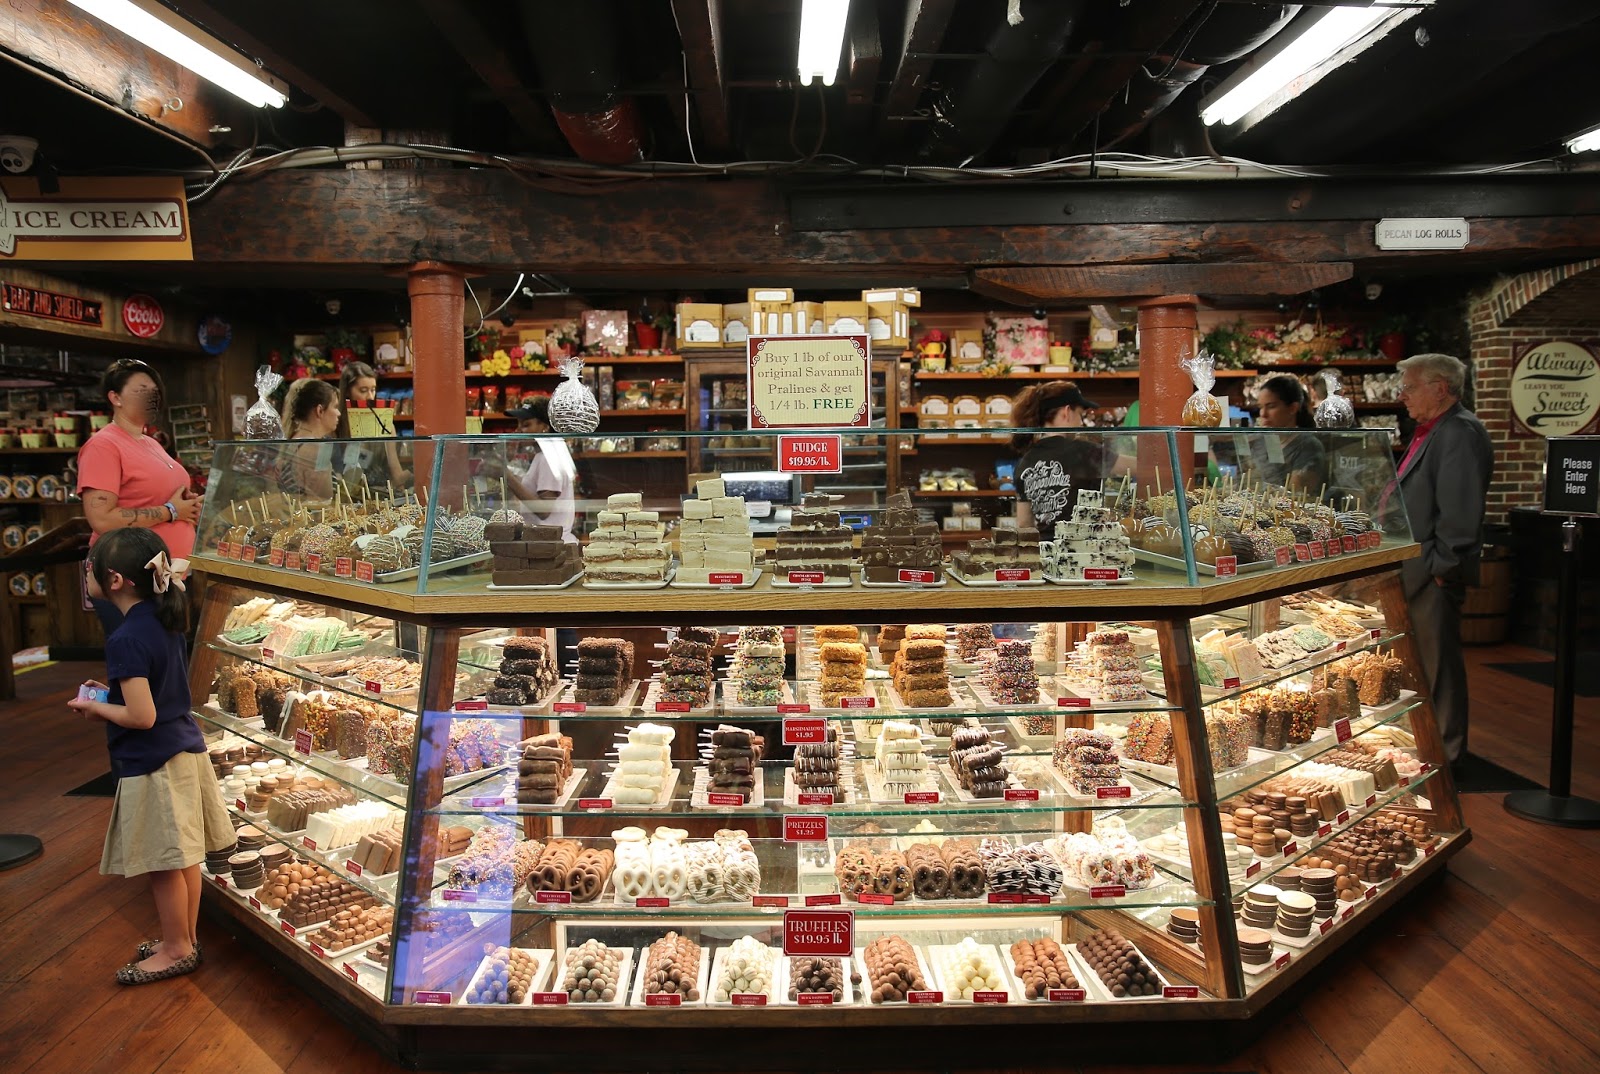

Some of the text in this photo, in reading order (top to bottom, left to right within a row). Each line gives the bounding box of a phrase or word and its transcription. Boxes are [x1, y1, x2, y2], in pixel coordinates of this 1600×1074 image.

[12, 210, 61, 228] ICE
[70, 210, 179, 229] CREAM
[1384, 228, 1462, 239] PECAN LOG ROLLS
[10, 286, 31, 312] BAR
[33, 291, 52, 315] AND
[54, 295, 83, 320] SHIELD
[127, 302, 161, 325] Coors
[764, 351, 854, 365] Buy 1 lb of our
[1527, 352, 1596, 376] Always
[757, 366, 863, 380] original Savannah
[767, 383, 852, 396] Pralines & get
[770, 398, 855, 411] 1/4 lb. FREE
[1533, 391, 1591, 413] Sweet
[792, 442, 828, 453] FUDGE
[1340, 456, 1359, 469] EXIT
[1563, 457, 1593, 470] Please
[1565, 470, 1588, 482] Enter
[1565, 482, 1587, 495] Here
[795, 731, 814, 739] $1.95
[787, 821, 824, 829] PRETZELS
[788, 920, 849, 932] TRUFFLES
[793, 932, 843, 945] $19.95 lb
